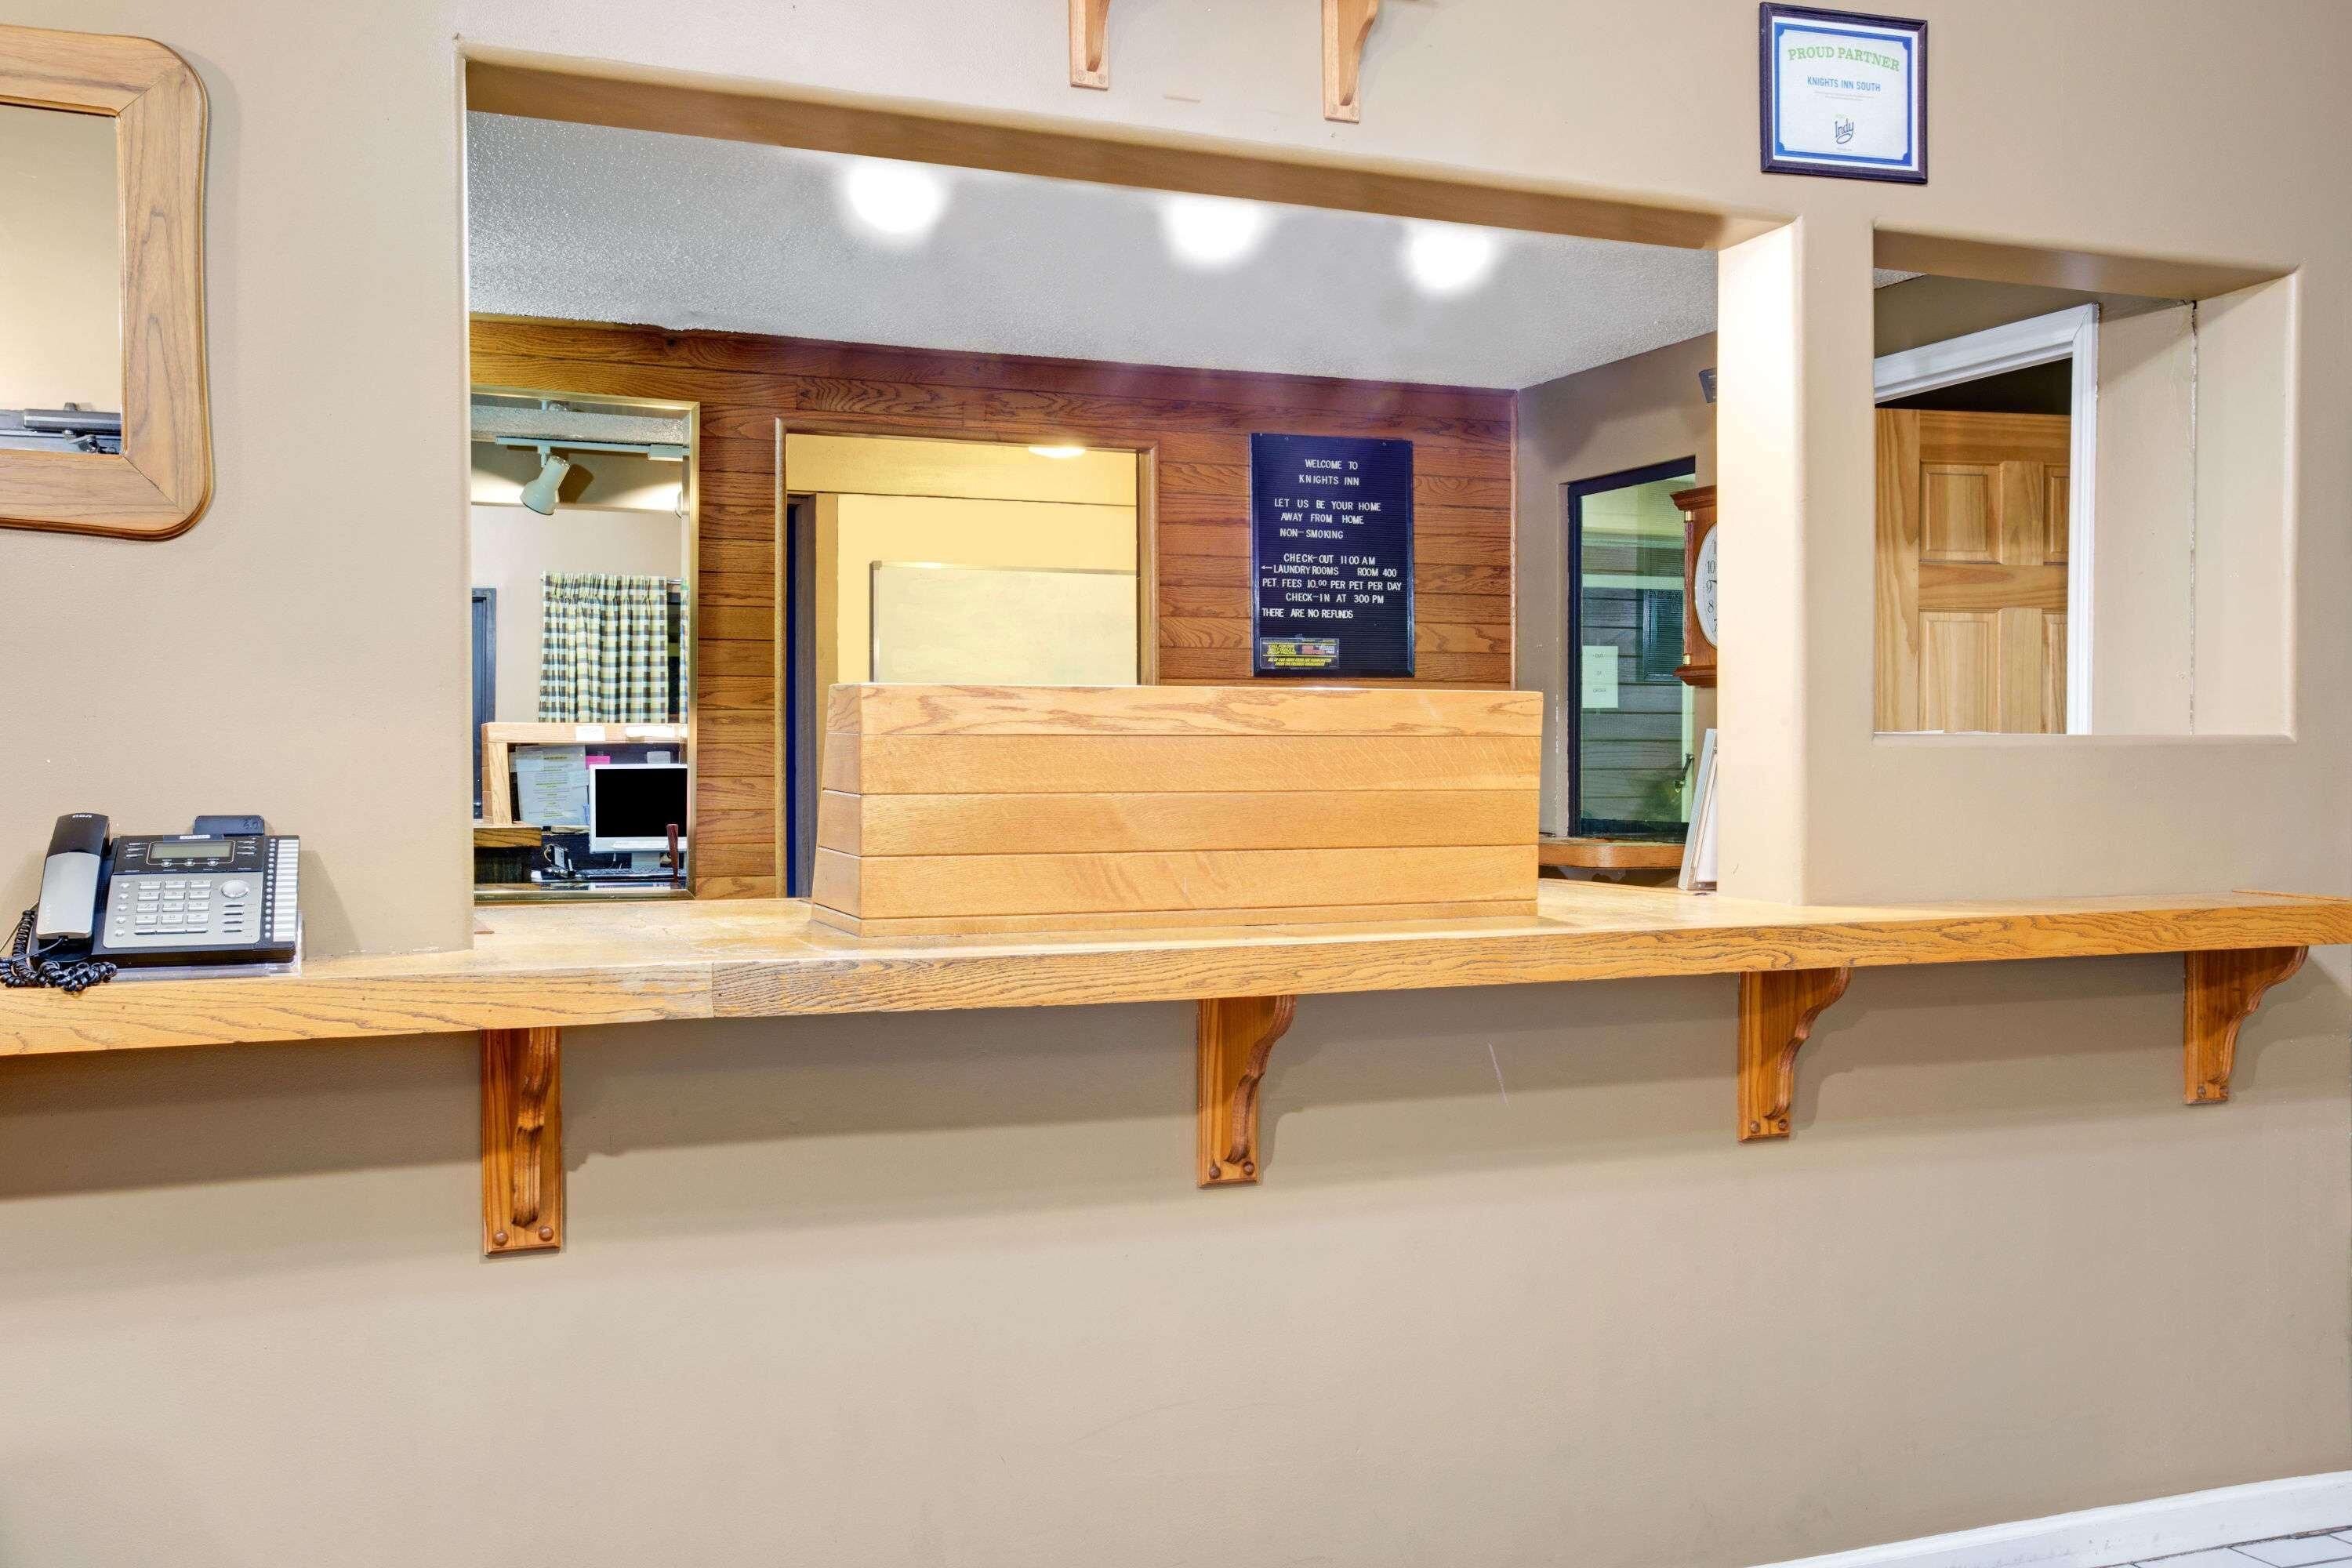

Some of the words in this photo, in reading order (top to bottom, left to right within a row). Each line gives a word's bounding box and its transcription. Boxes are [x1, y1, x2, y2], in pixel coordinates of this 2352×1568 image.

[1788, 46, 1835, 61] PROUD
[1838, 47, 1900, 71] PARTNER
[1807, 76, 1838, 87] KNIGHTS
[1842, 80, 1853, 89] INN
[1857, 82, 1881, 91] SOUTH
[1835, 118, 1855, 144] Indy
[1305, 459, 1342, 470] WELCOME
[1348, 461, 1358, 470] TO
[1299, 475, 1339, 485] KNIGHTS
[1345, 477, 1359, 485] INN
[1275, 499, 1289, 507] LET
[1298, 499, 1308, 508] US
[1316, 500, 1325, 509] BE
[1331, 501, 1352, 510] YOUR
[1359, 503, 1381, 511] HOME
[1281, 513, 1302, 521] AWAY
[1311, 514, 1332, 522] FROM
[1342, 515, 1364, 524] HOME
[1284, 554, 1334, 564] CHECK-OUT
[1362, 557, 1375, 565] AM
[1274, 564, 1309, 574] LAUNDRY
[1312, 565, 1338, 575] ROOMS
[1357, 568, 1378, 576] ROOM
[1707, 560, 1716, 574] 10
[1282, 579, 1301, 588] FEES
[1330, 581, 1345, 590] PER
[1368, 582, 1382, 590] PER
[1388, 582, 1402, 591] DAY
[1286, 593, 1330, 602] CHECK-IN
[1372, 595, 1384, 604] PM
[1708, 601, 1714, 613] 8
[1262, 608, 1284, 618] THERE
[1290, 608, 1305, 618] ARE
[1308, 609, 1319, 618] NO
[1322, 610, 1353, 619] REFUNDS
